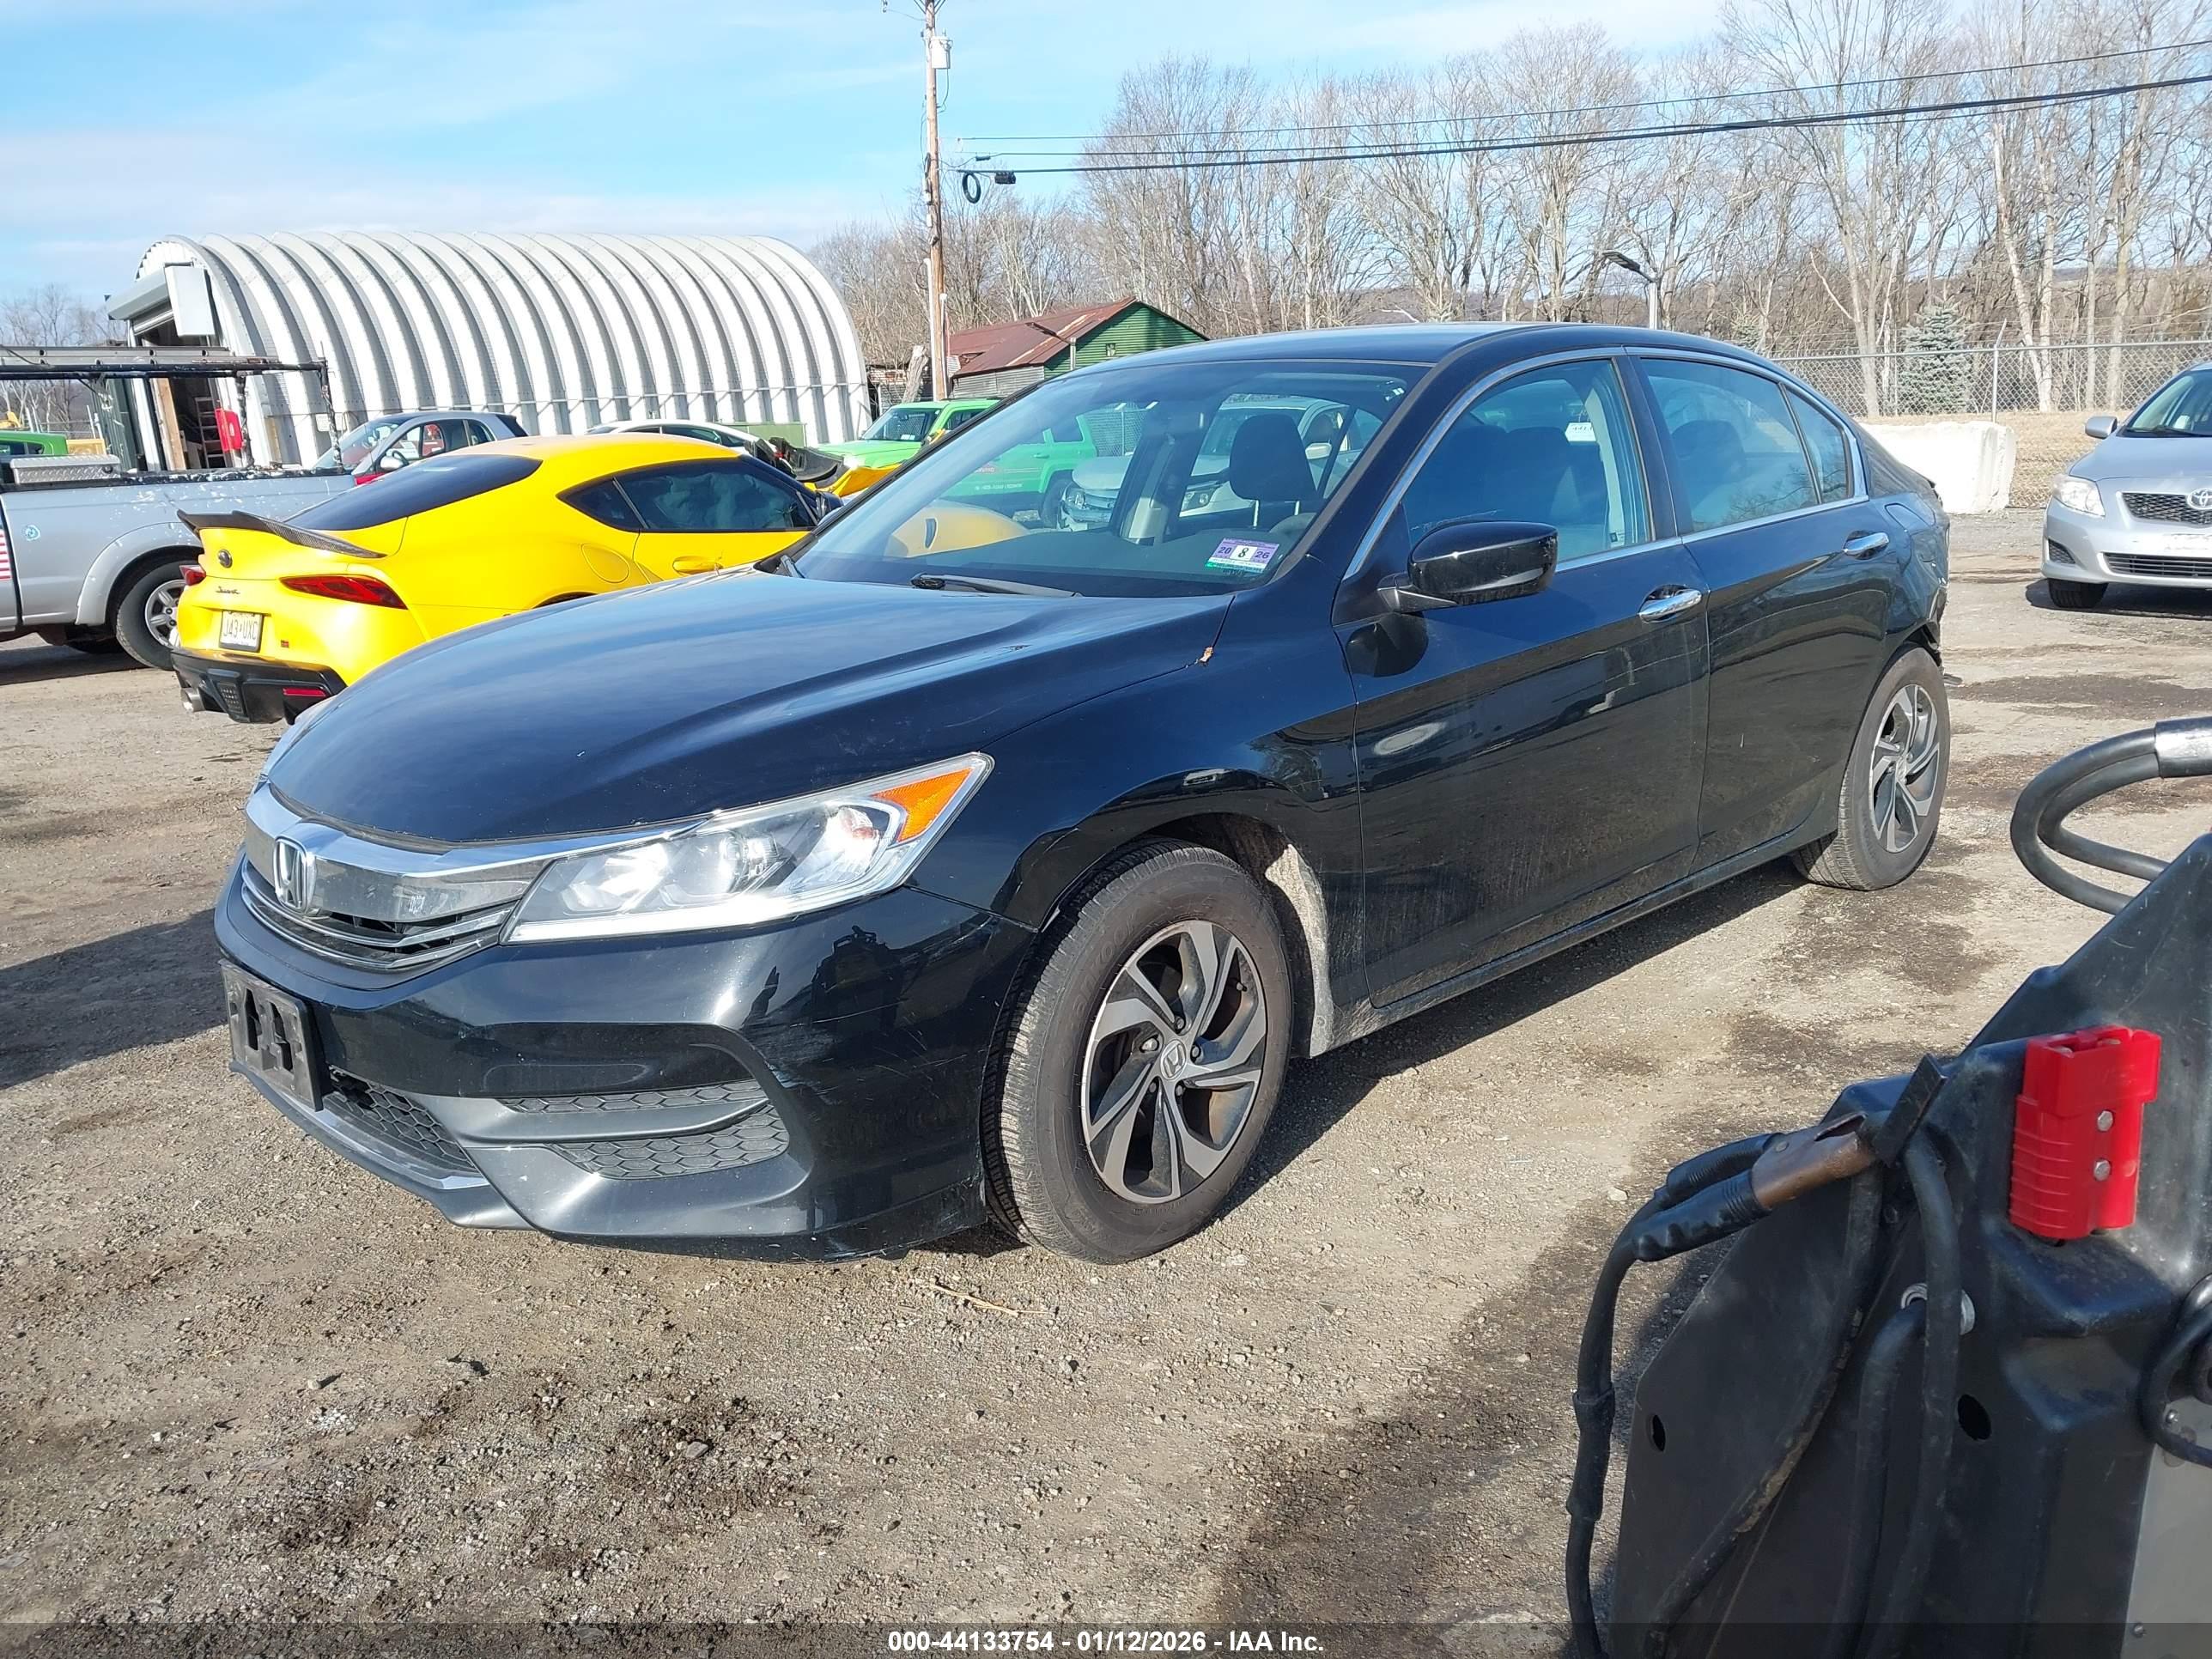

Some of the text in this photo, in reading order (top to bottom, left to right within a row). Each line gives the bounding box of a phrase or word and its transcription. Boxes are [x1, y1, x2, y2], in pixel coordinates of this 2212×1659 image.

[1218, 546, 1270, 560] 20 8 26
